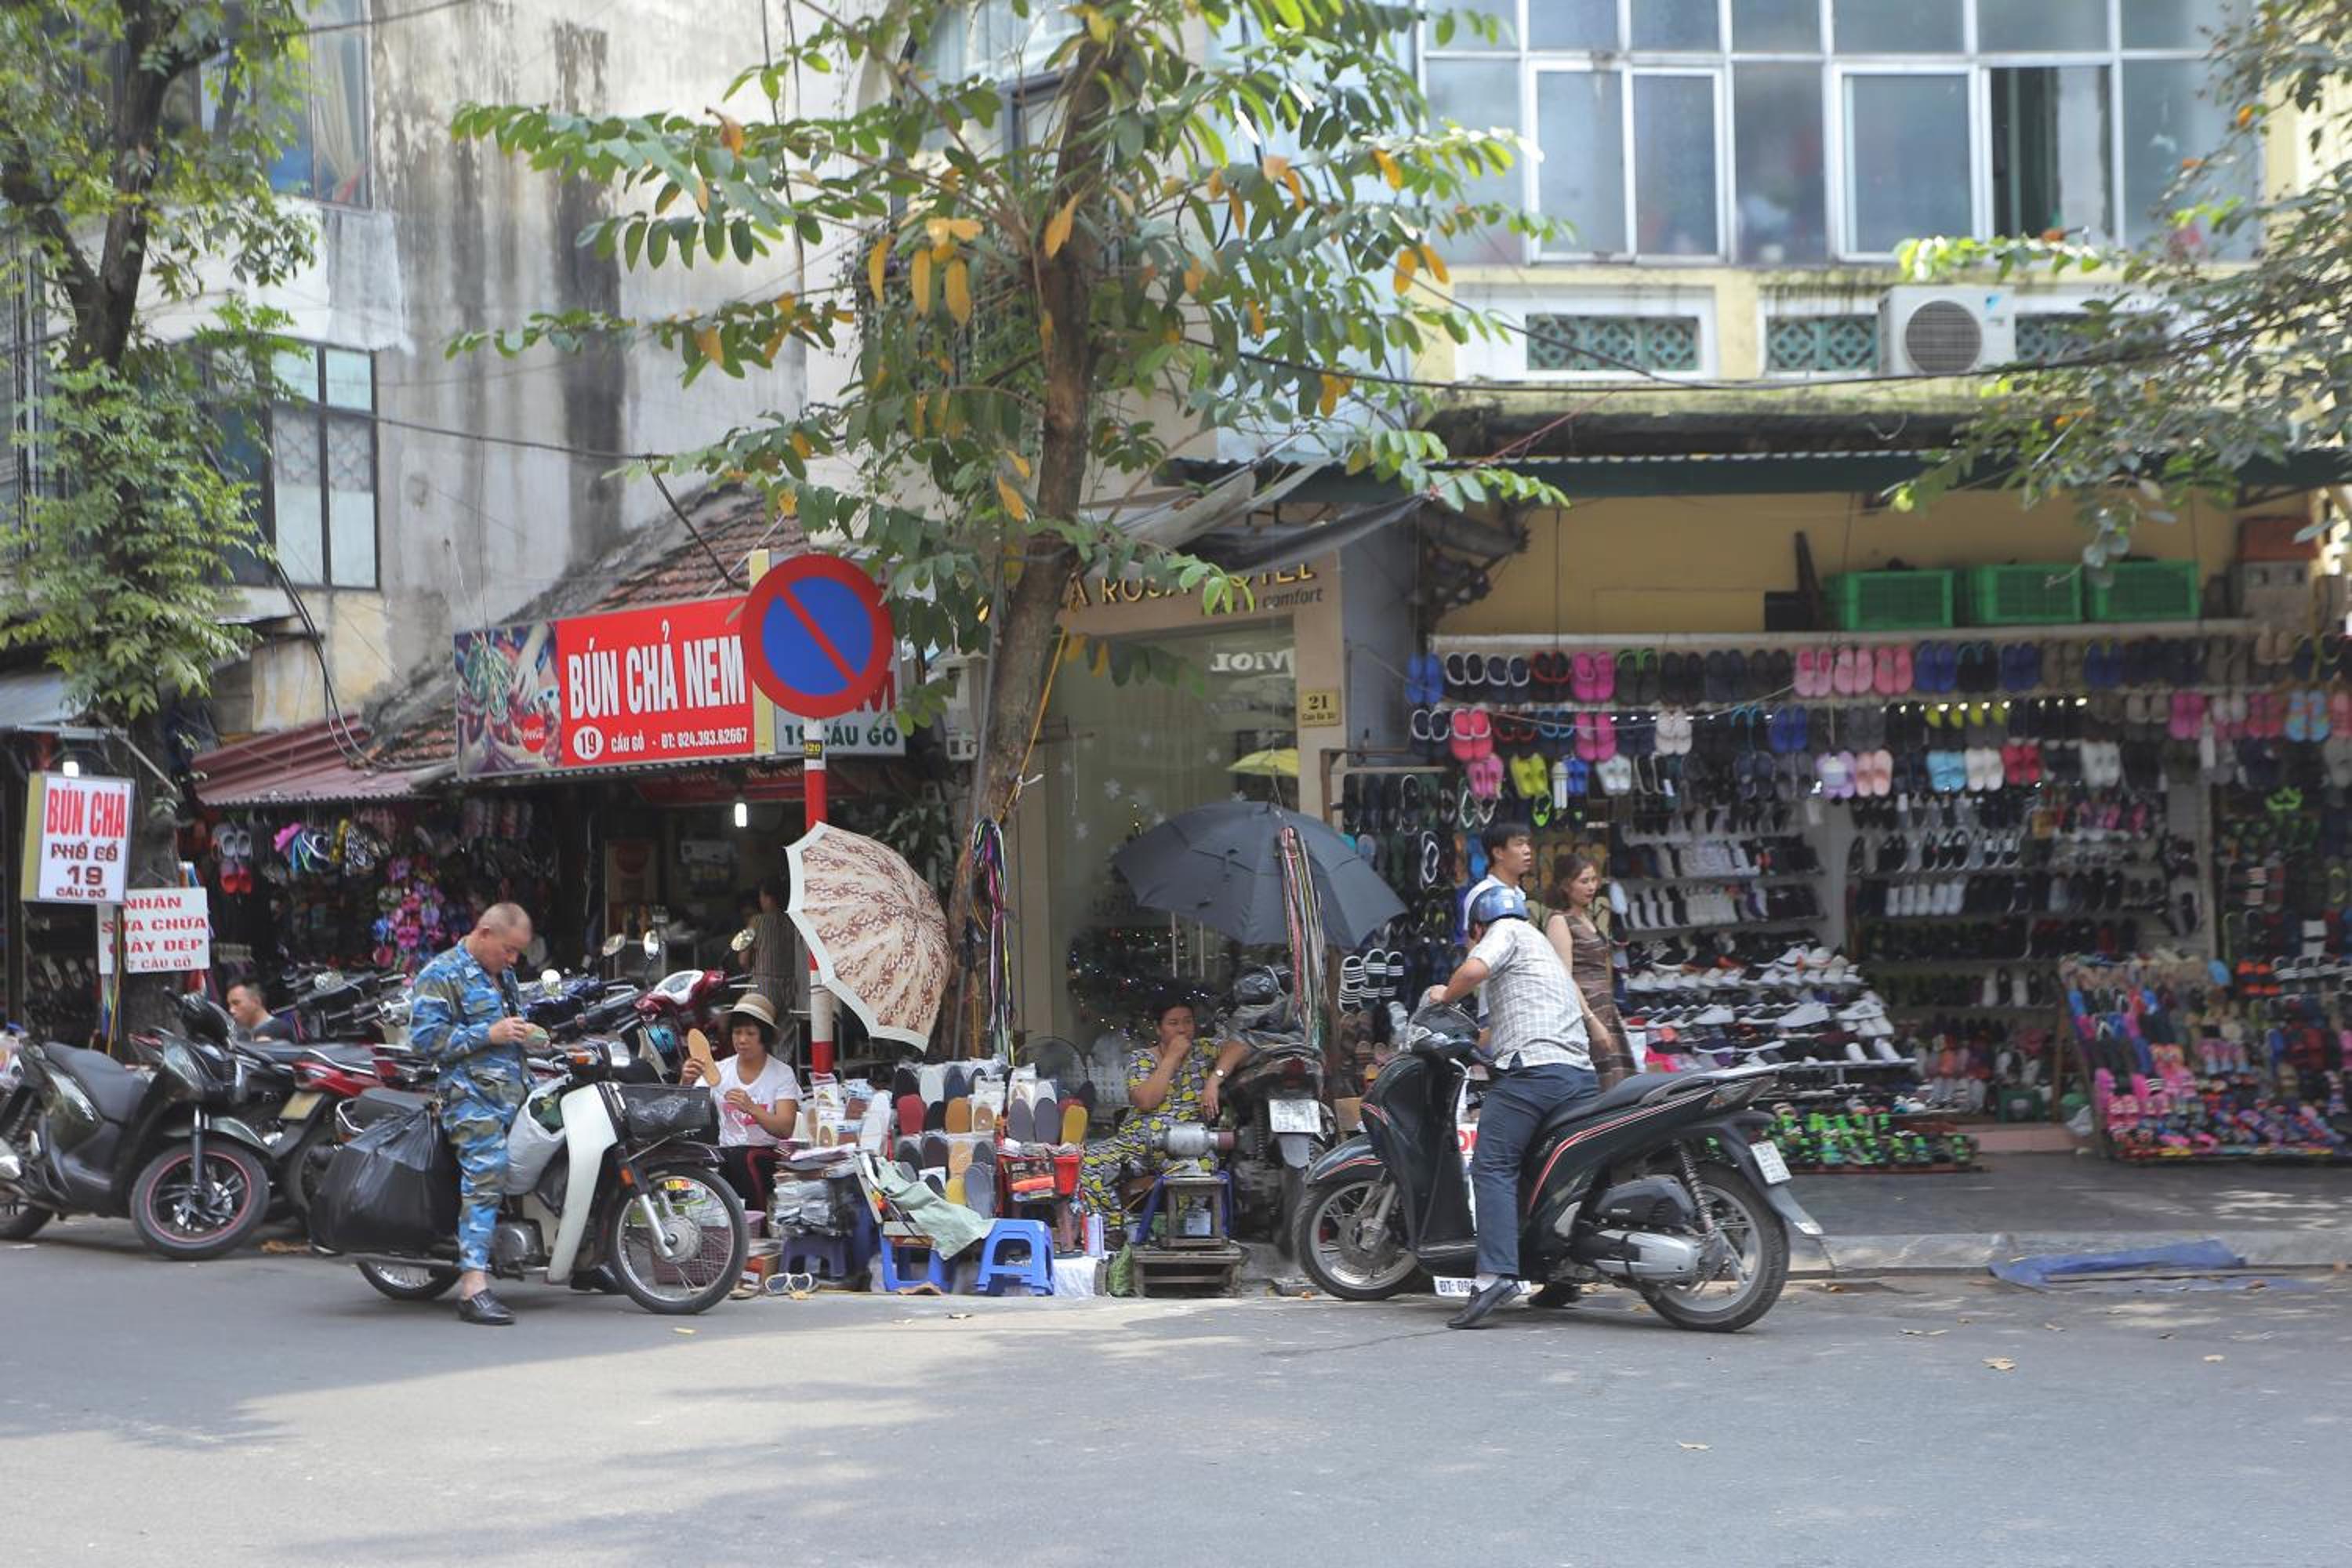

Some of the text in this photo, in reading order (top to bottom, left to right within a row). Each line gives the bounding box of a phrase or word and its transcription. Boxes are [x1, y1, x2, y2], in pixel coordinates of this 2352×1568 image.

[568, 619, 746, 720] BÚN CHẢ NEM
[1308, 695, 1327, 710] 21
[580, 731, 596, 754] 19
[46, 782, 125, 838] BÚN CHẢ
[67, 865, 103, 885] 19
